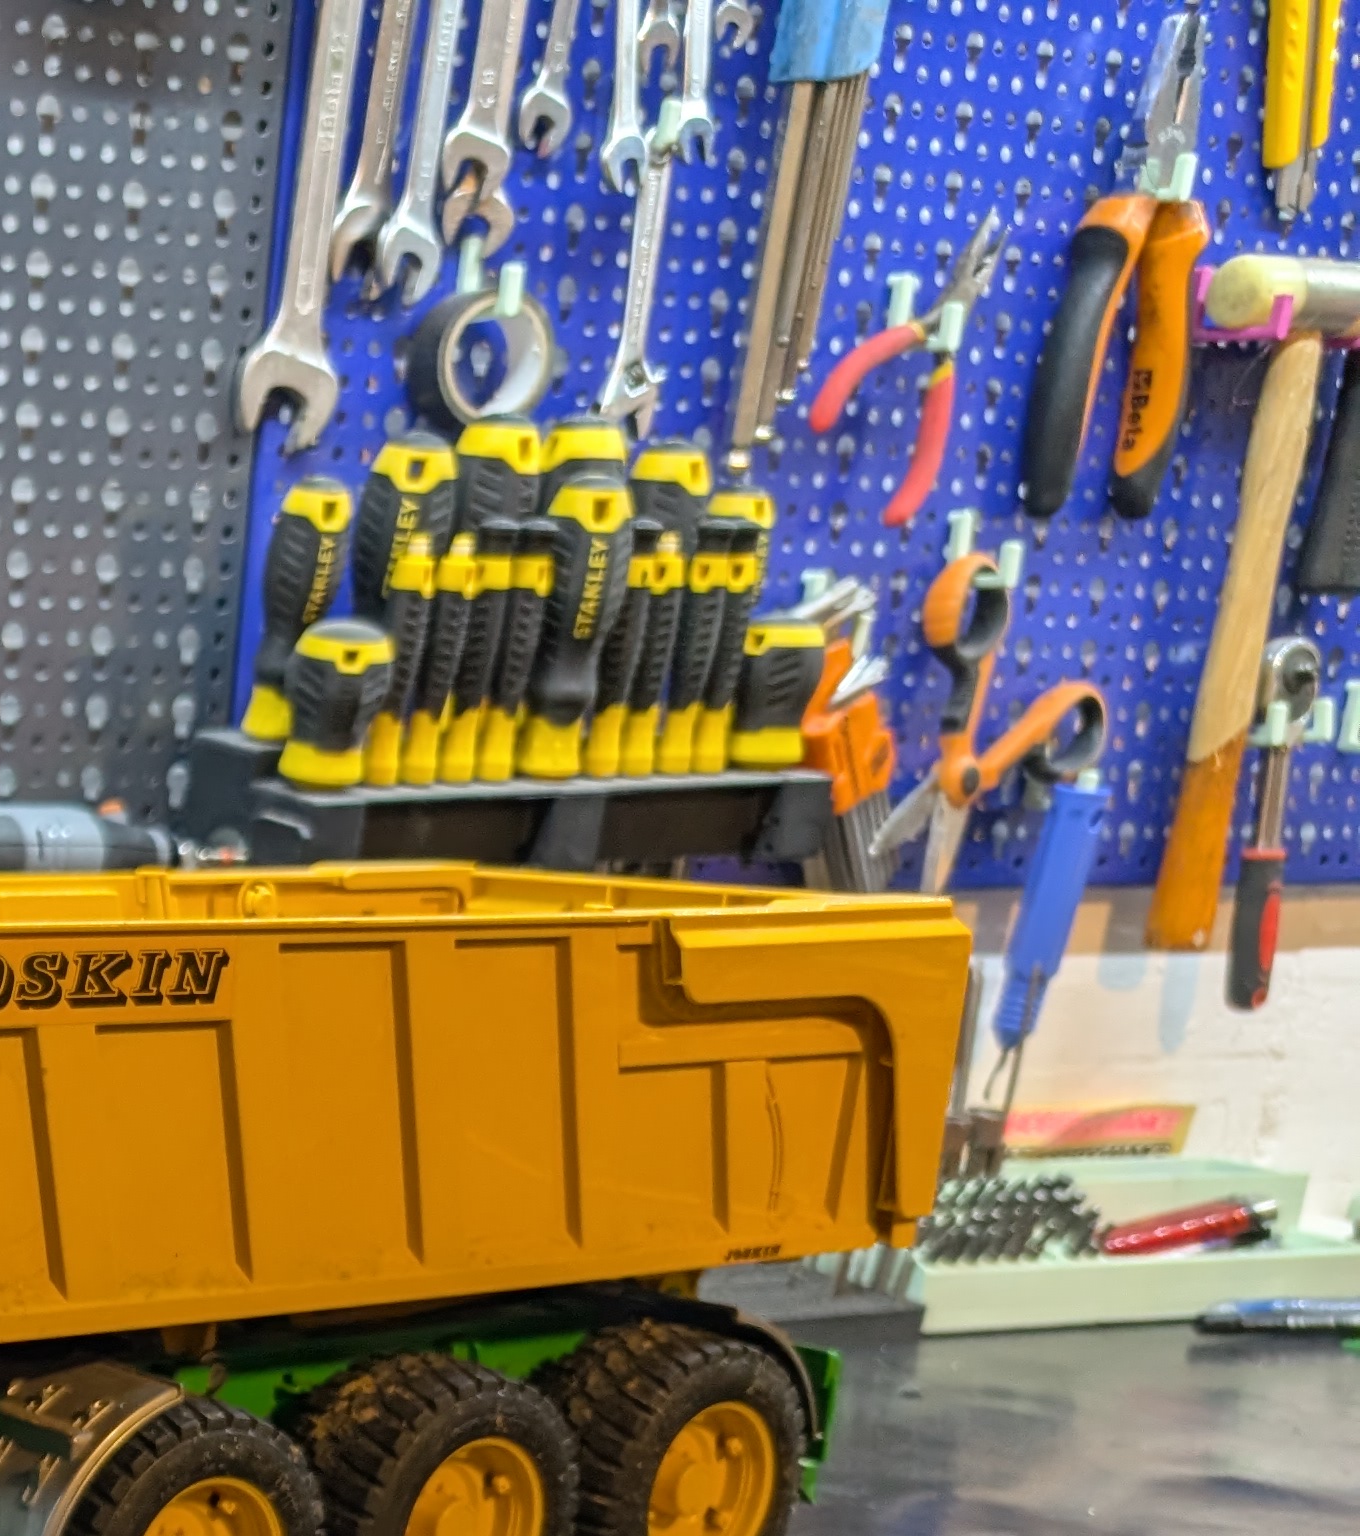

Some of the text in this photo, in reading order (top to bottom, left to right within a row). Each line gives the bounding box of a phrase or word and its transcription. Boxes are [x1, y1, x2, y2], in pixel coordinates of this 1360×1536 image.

[1122, 394, 1150, 452] Beta
[303, 535, 336, 623] STANLEY
[573, 537, 610, 640] STANLEY
